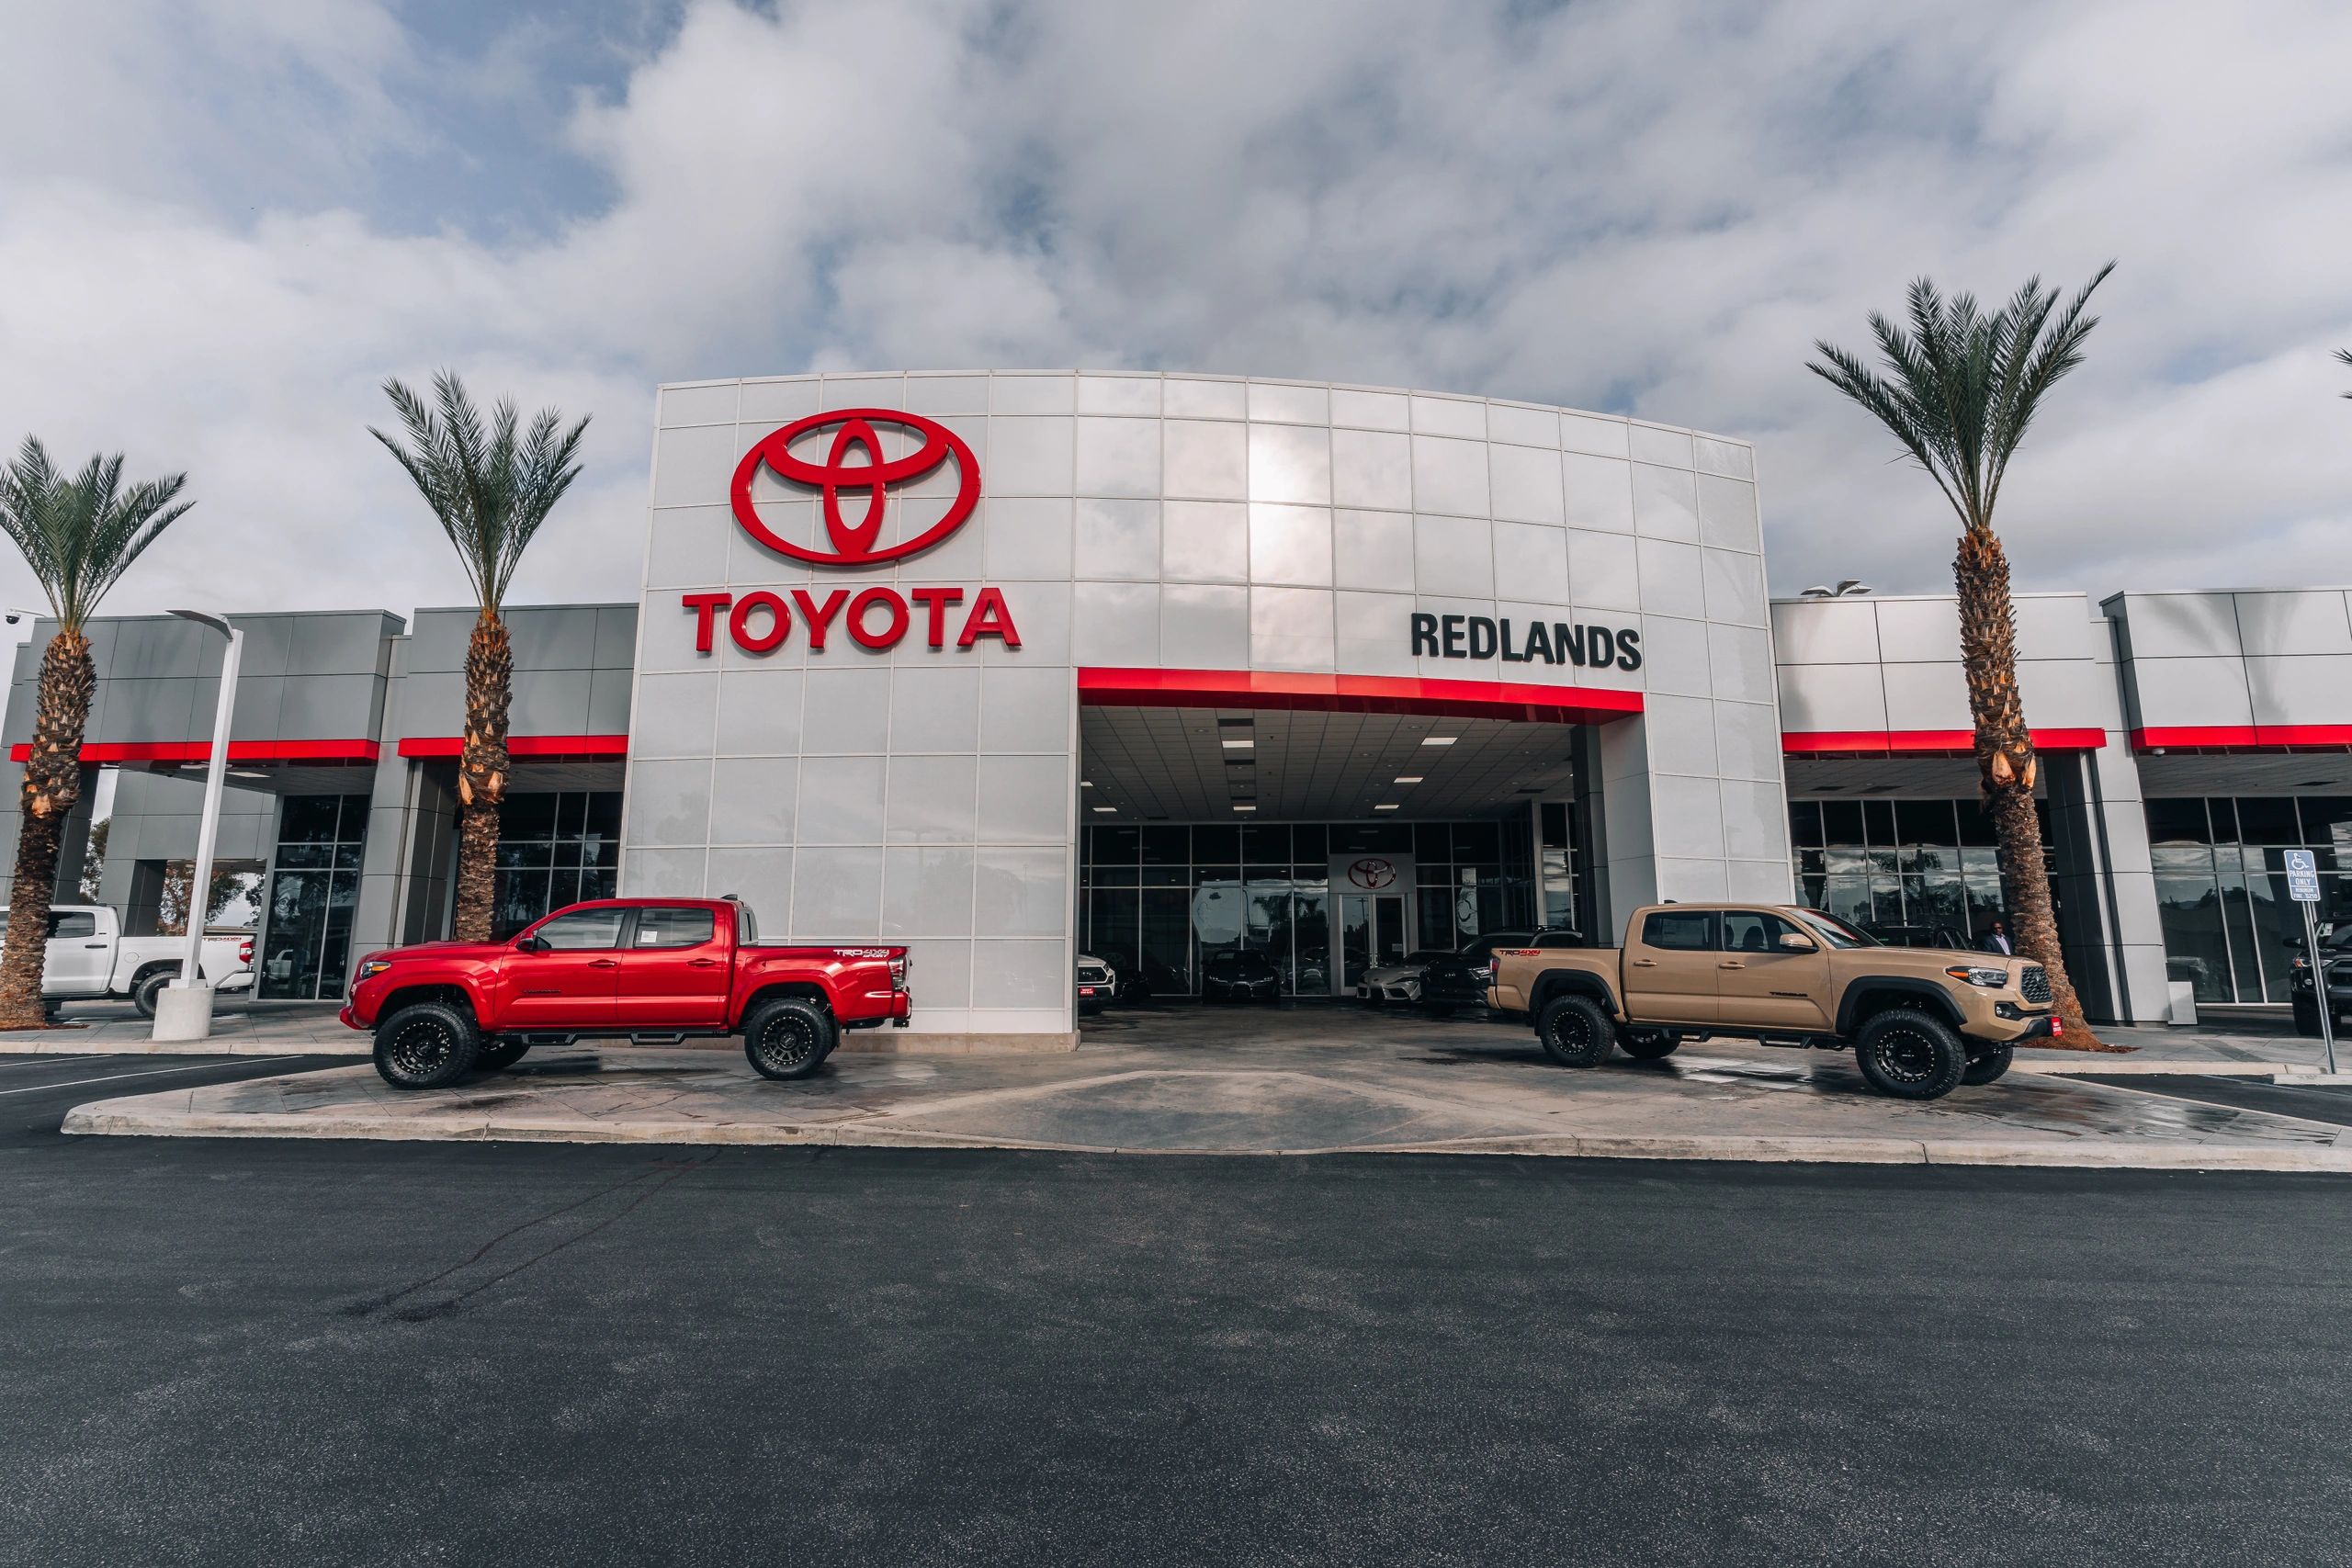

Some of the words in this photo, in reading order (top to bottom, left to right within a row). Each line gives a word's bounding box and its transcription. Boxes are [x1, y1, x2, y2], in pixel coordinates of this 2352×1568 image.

[682, 587, 1023, 653] TOYOTA
[1411, 612, 1642, 671] REDLANDS
[2289, 870, 2315, 878] PARKING
[2295, 877, 2311, 886] ONLY
